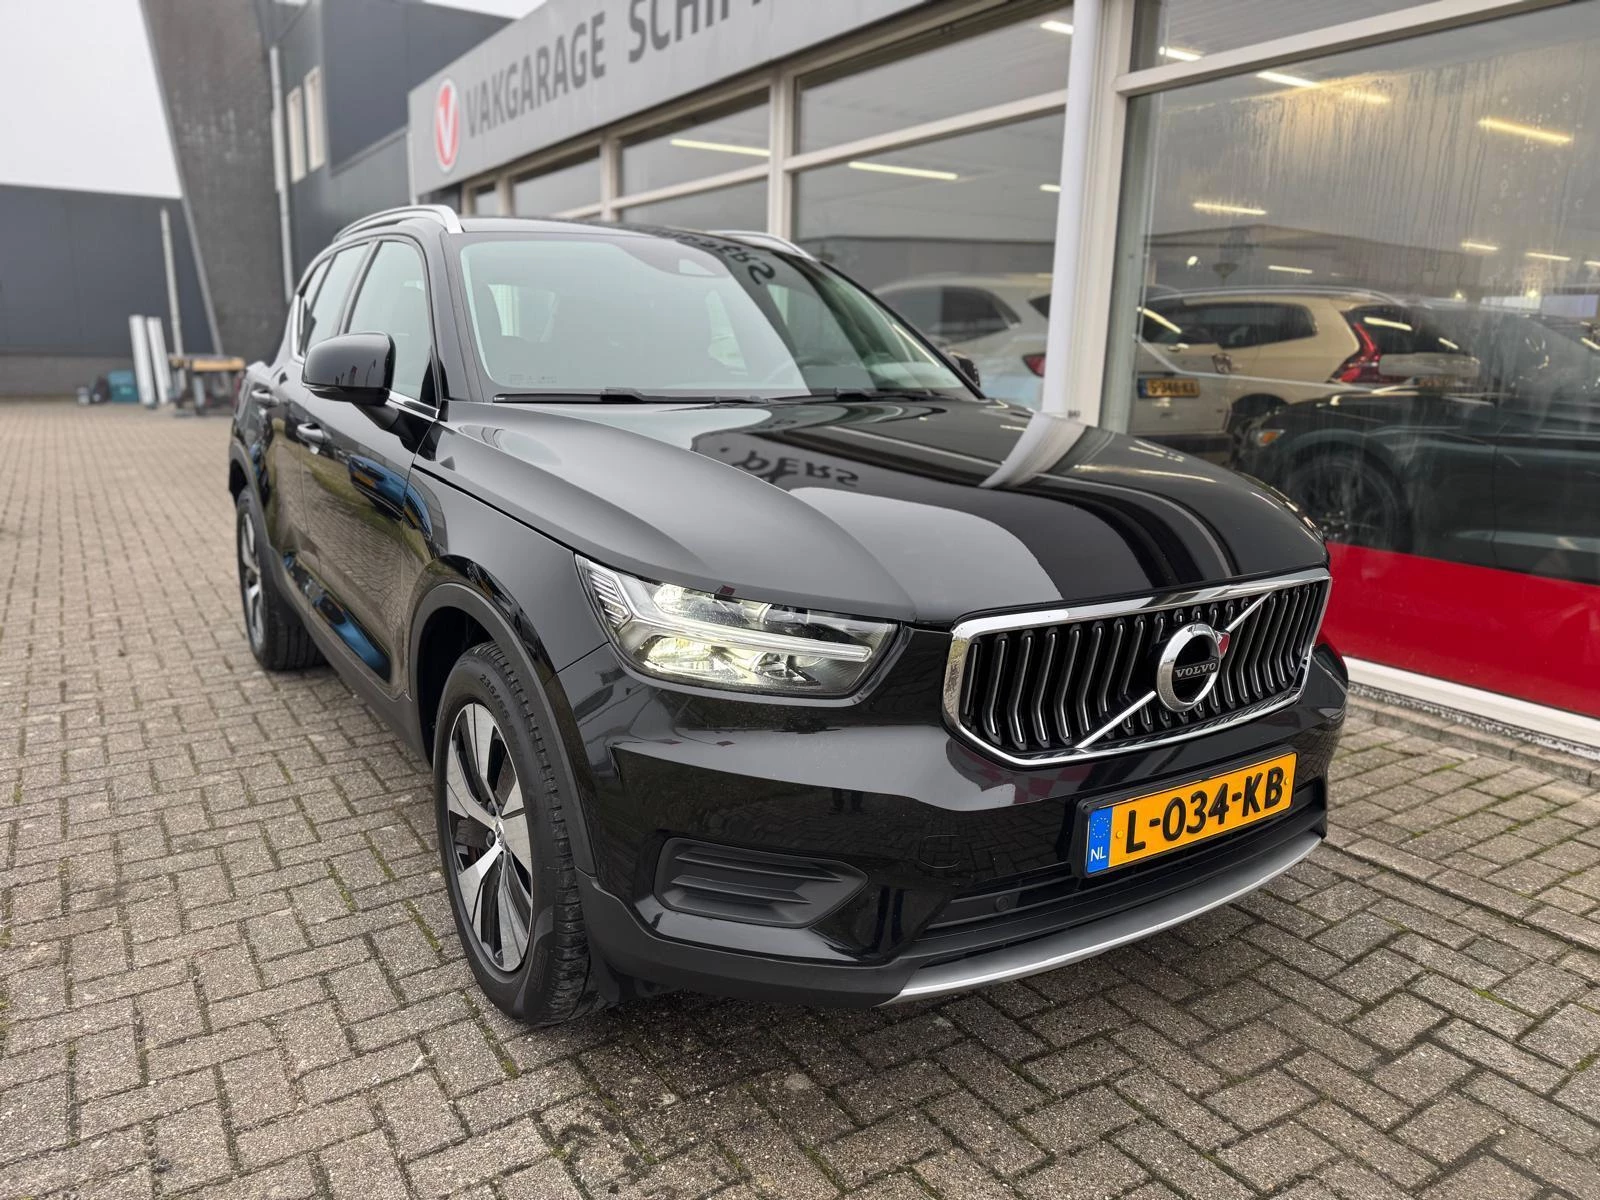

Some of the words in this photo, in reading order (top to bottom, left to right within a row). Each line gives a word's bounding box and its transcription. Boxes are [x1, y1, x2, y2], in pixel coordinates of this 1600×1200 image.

[466, 10, 605, 138] VAKGARAGE
[1174, 662, 1217, 678] VOLVO
[1090, 847, 1107, 862] NL
[1125, 766, 1285, 854] L-034-KB
